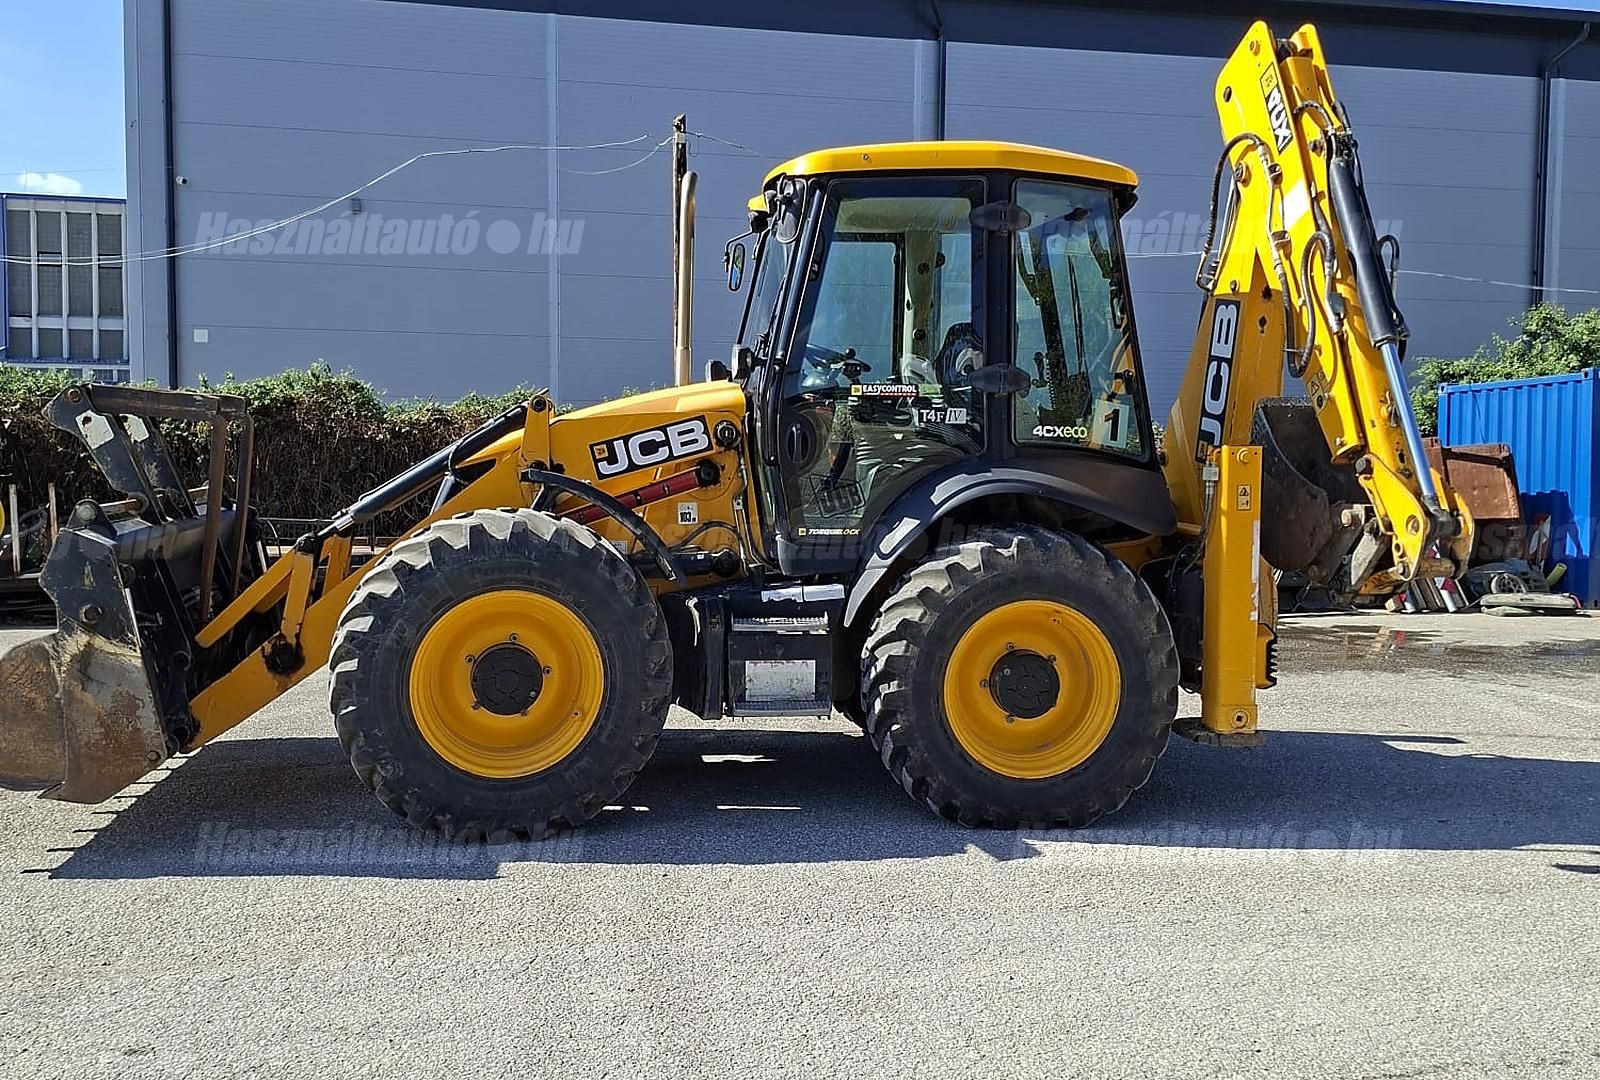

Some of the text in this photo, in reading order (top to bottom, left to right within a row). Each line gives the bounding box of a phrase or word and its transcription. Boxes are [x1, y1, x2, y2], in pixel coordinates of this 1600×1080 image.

[862, 384, 917, 394] EASYCONTROL
[1201, 304, 1237, 446] JCB
[597, 419, 709, 475] JCB
[1104, 408, 1121, 442] 1
